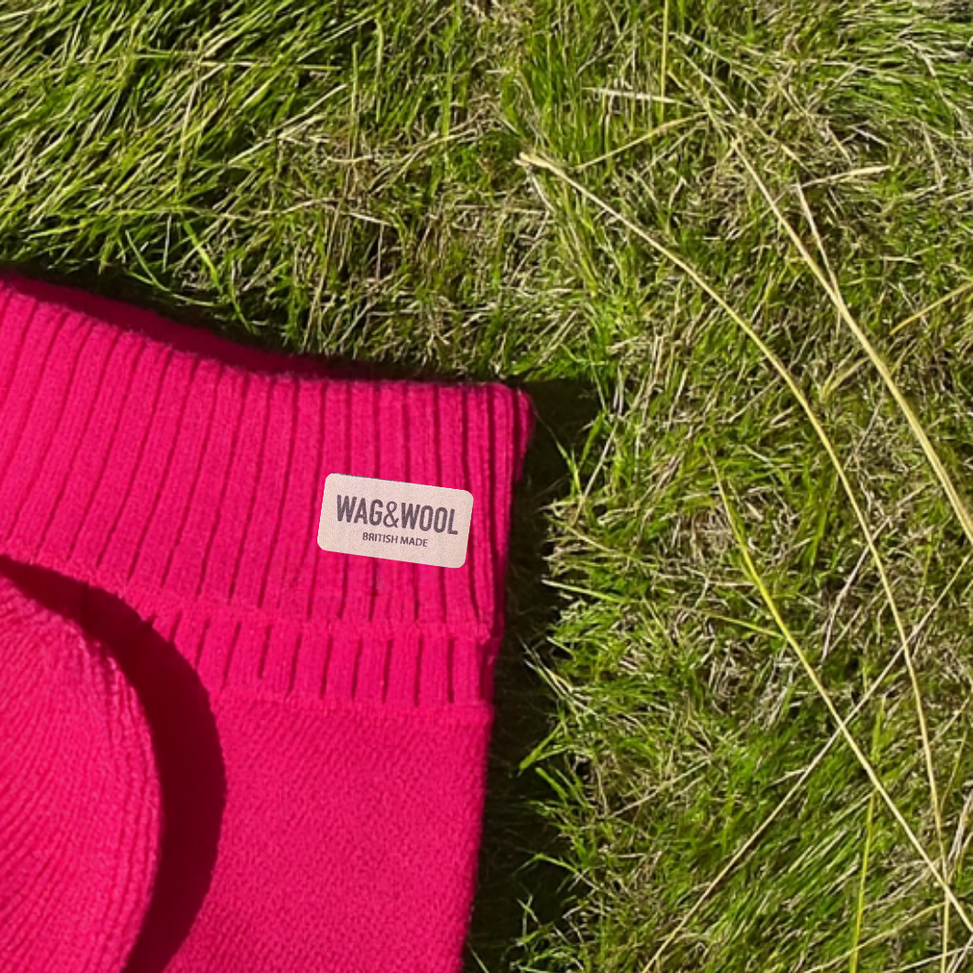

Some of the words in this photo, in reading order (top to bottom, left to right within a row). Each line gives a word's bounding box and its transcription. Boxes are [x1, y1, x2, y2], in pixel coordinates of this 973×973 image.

[336, 494, 459, 535] WAG&WOOL
[362, 532, 399, 544] BRITISH
[399, 536, 429, 548] MADE
